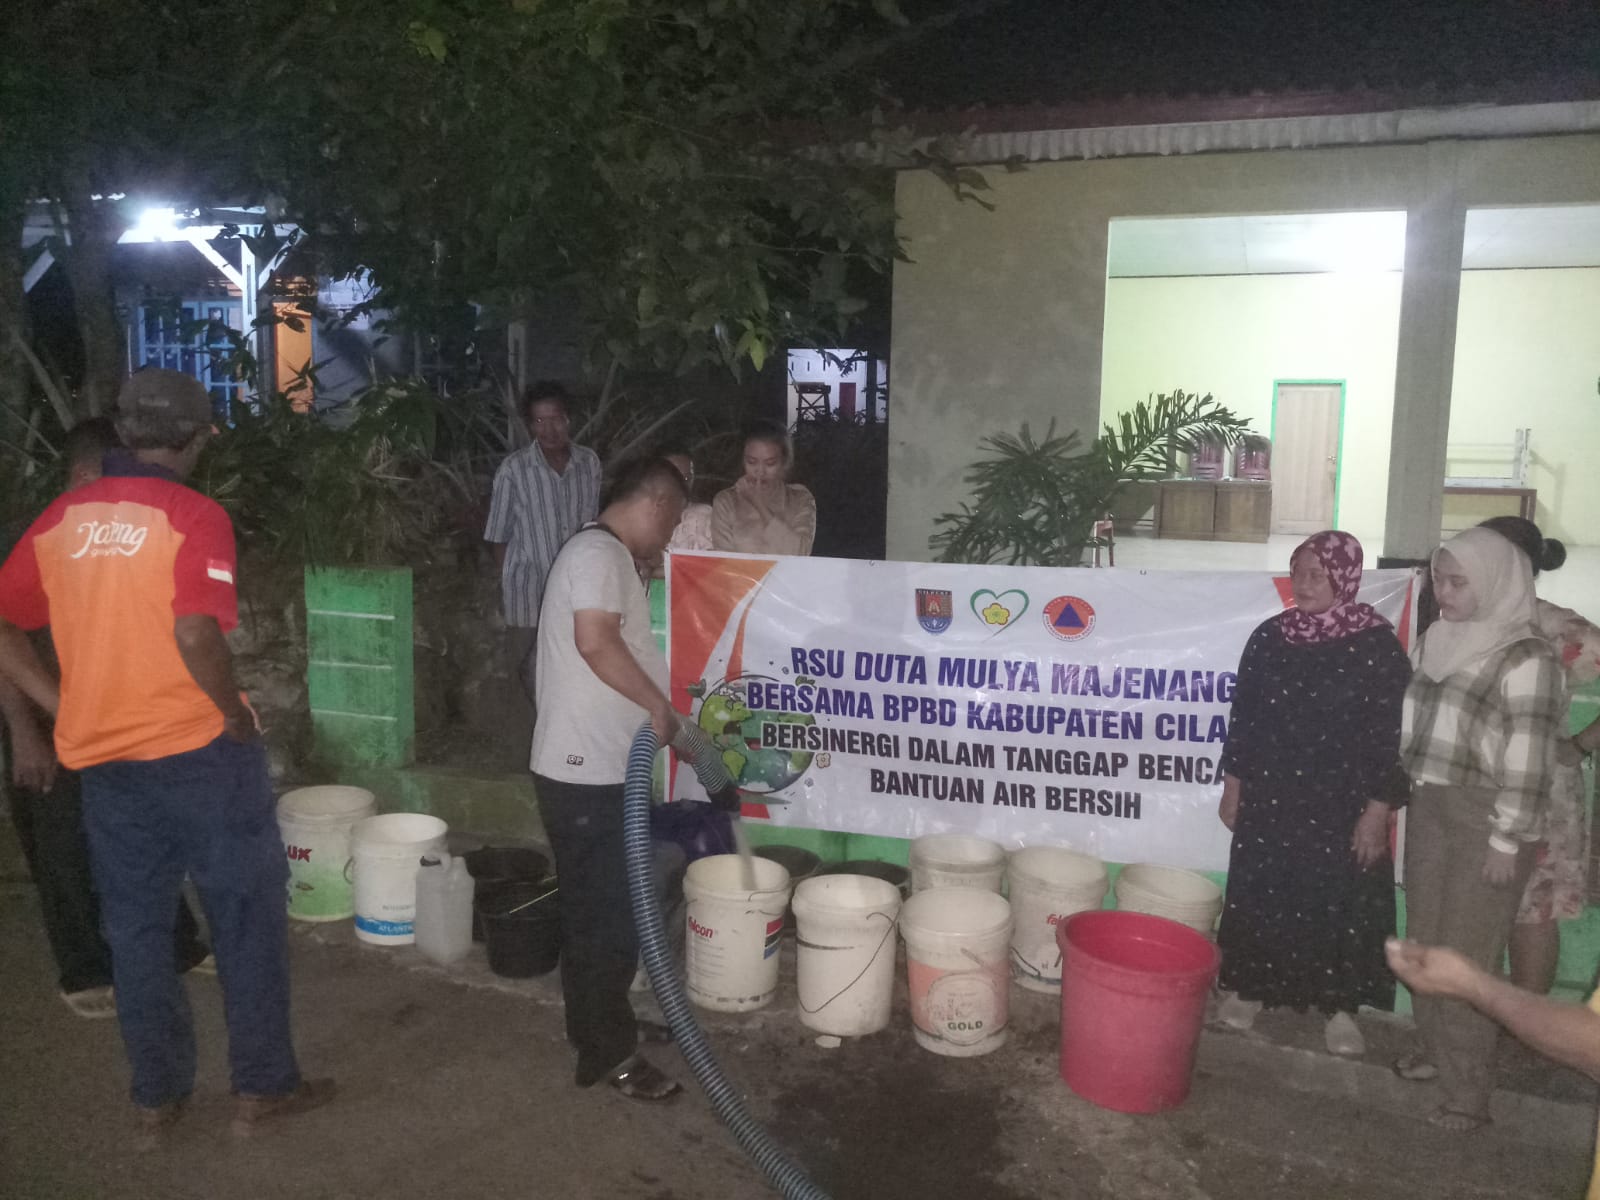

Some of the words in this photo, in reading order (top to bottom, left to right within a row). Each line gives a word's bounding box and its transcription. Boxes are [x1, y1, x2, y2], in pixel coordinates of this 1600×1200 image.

[790, 647, 845, 679] RSU
[854, 651, 928, 685] DUTA
[938, 657, 1040, 693] MULYA
[1050, 663, 1238, 704] MAJENANG
[747, 682, 874, 720] BERSAMA
[882, 694, 957, 727] BPBD
[966, 700, 1143, 740] KABUPATEN
[762, 723, 900, 760] BERSINERGI
[908, 736, 995, 769] DALAM
[1003, 746, 1129, 778] TANGGAP
[870, 768, 985, 805] BANTUAN
[993, 781, 1036, 809] AIR
[1045, 785, 1142, 820] BERSIH
[947, 1020, 983, 1032] GOLD
